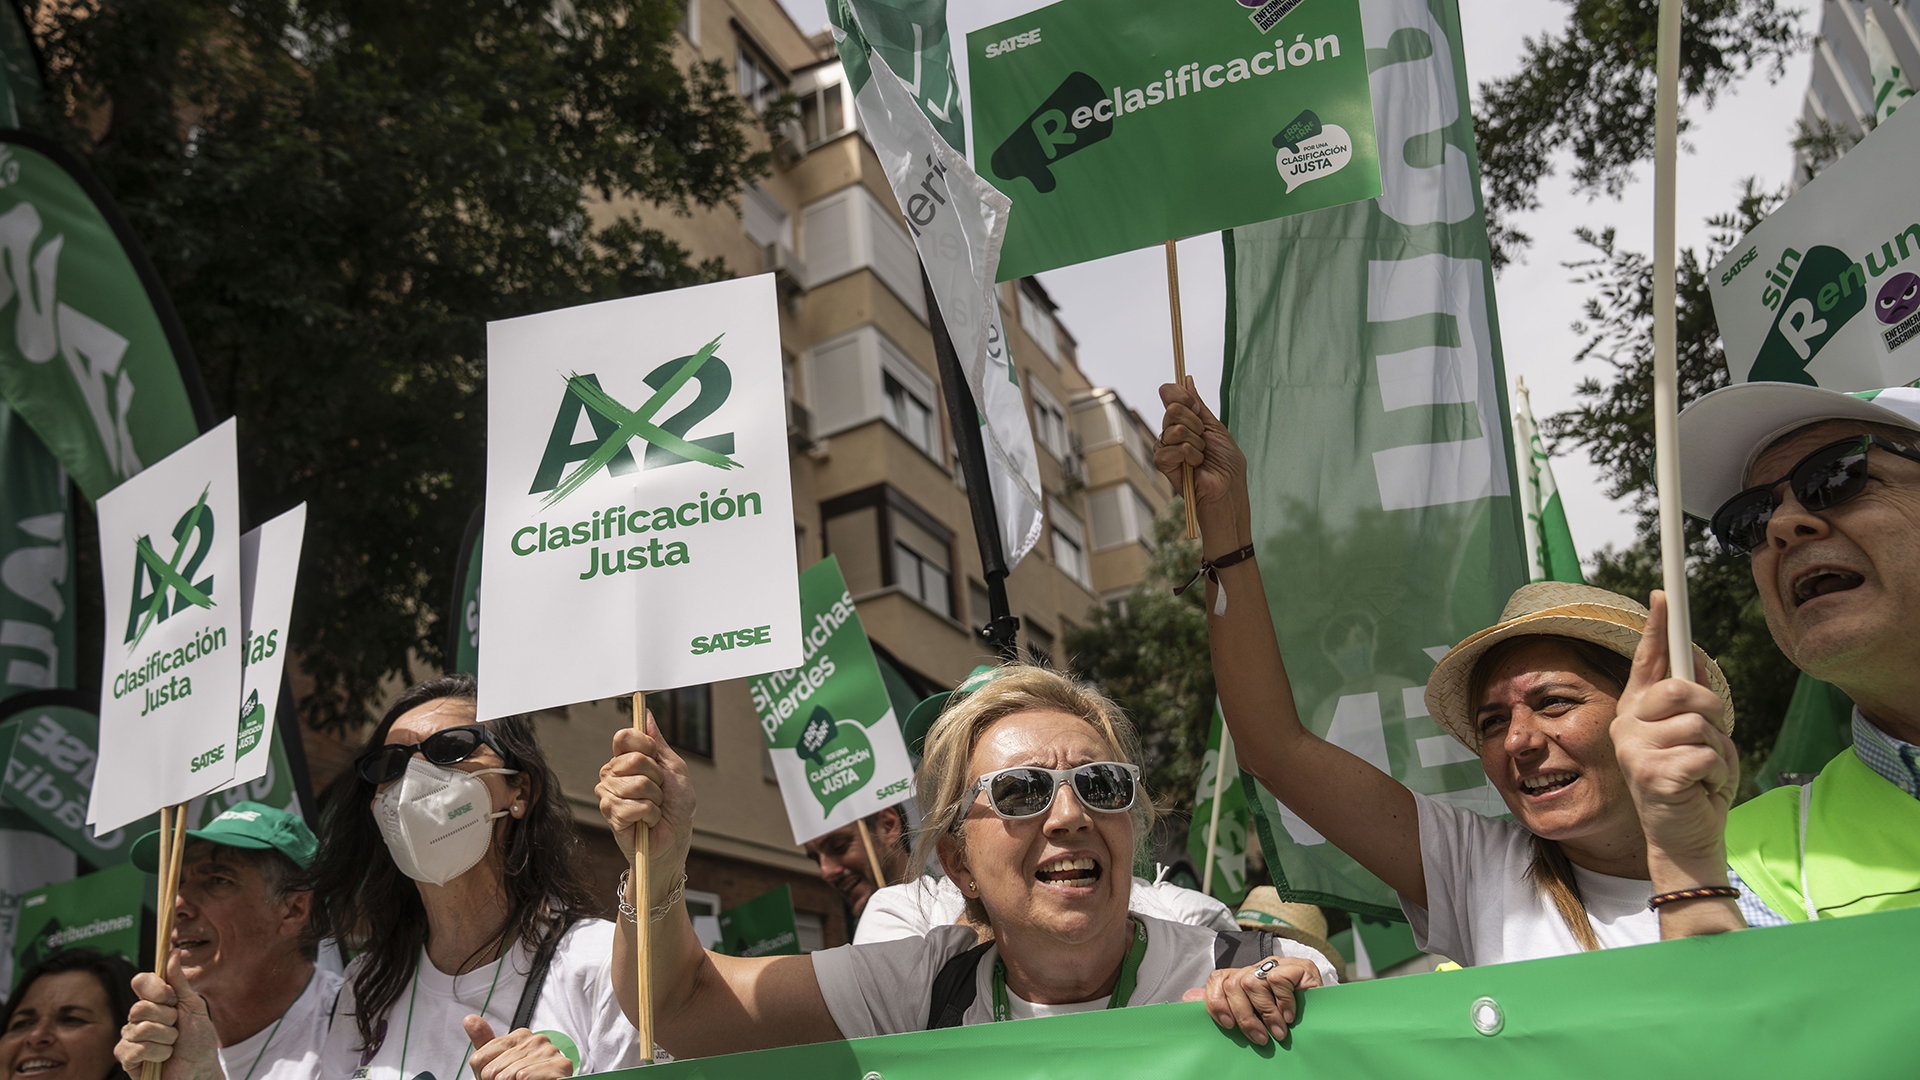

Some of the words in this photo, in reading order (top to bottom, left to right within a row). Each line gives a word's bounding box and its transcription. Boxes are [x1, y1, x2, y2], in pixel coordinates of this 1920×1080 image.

[985, 28, 1042, 59] SATSE
[1031, 34, 1341, 159] Reclasificación
[1281, 145, 1348, 166] CLASIFICACIÓN
[1290, 158, 1333, 175] JUSTA
[1303, 144, 1316, 152] POR
[1721, 245, 1759, 287] SATSE
[1762, 247, 1802, 312] sin
[527, 354, 735, 495] A2
[510, 488, 762, 556] Clasificación
[123, 504, 215, 645] A2
[579, 537, 690, 580] Justa
[690, 624, 772, 655] SATSE
[802, 590, 856, 665] uchas
[113, 626, 227, 699] Clasificación
[141, 676, 192, 717] Justa
[761, 655, 836, 743] pierdes
[190, 744, 225, 773] SATSE
[810, 748, 871, 782] CLASIFICACIÓN
[821, 768, 860, 795] JUSTA
[876, 778, 910, 800] SATSE
[447, 802, 473, 820] SATSE
